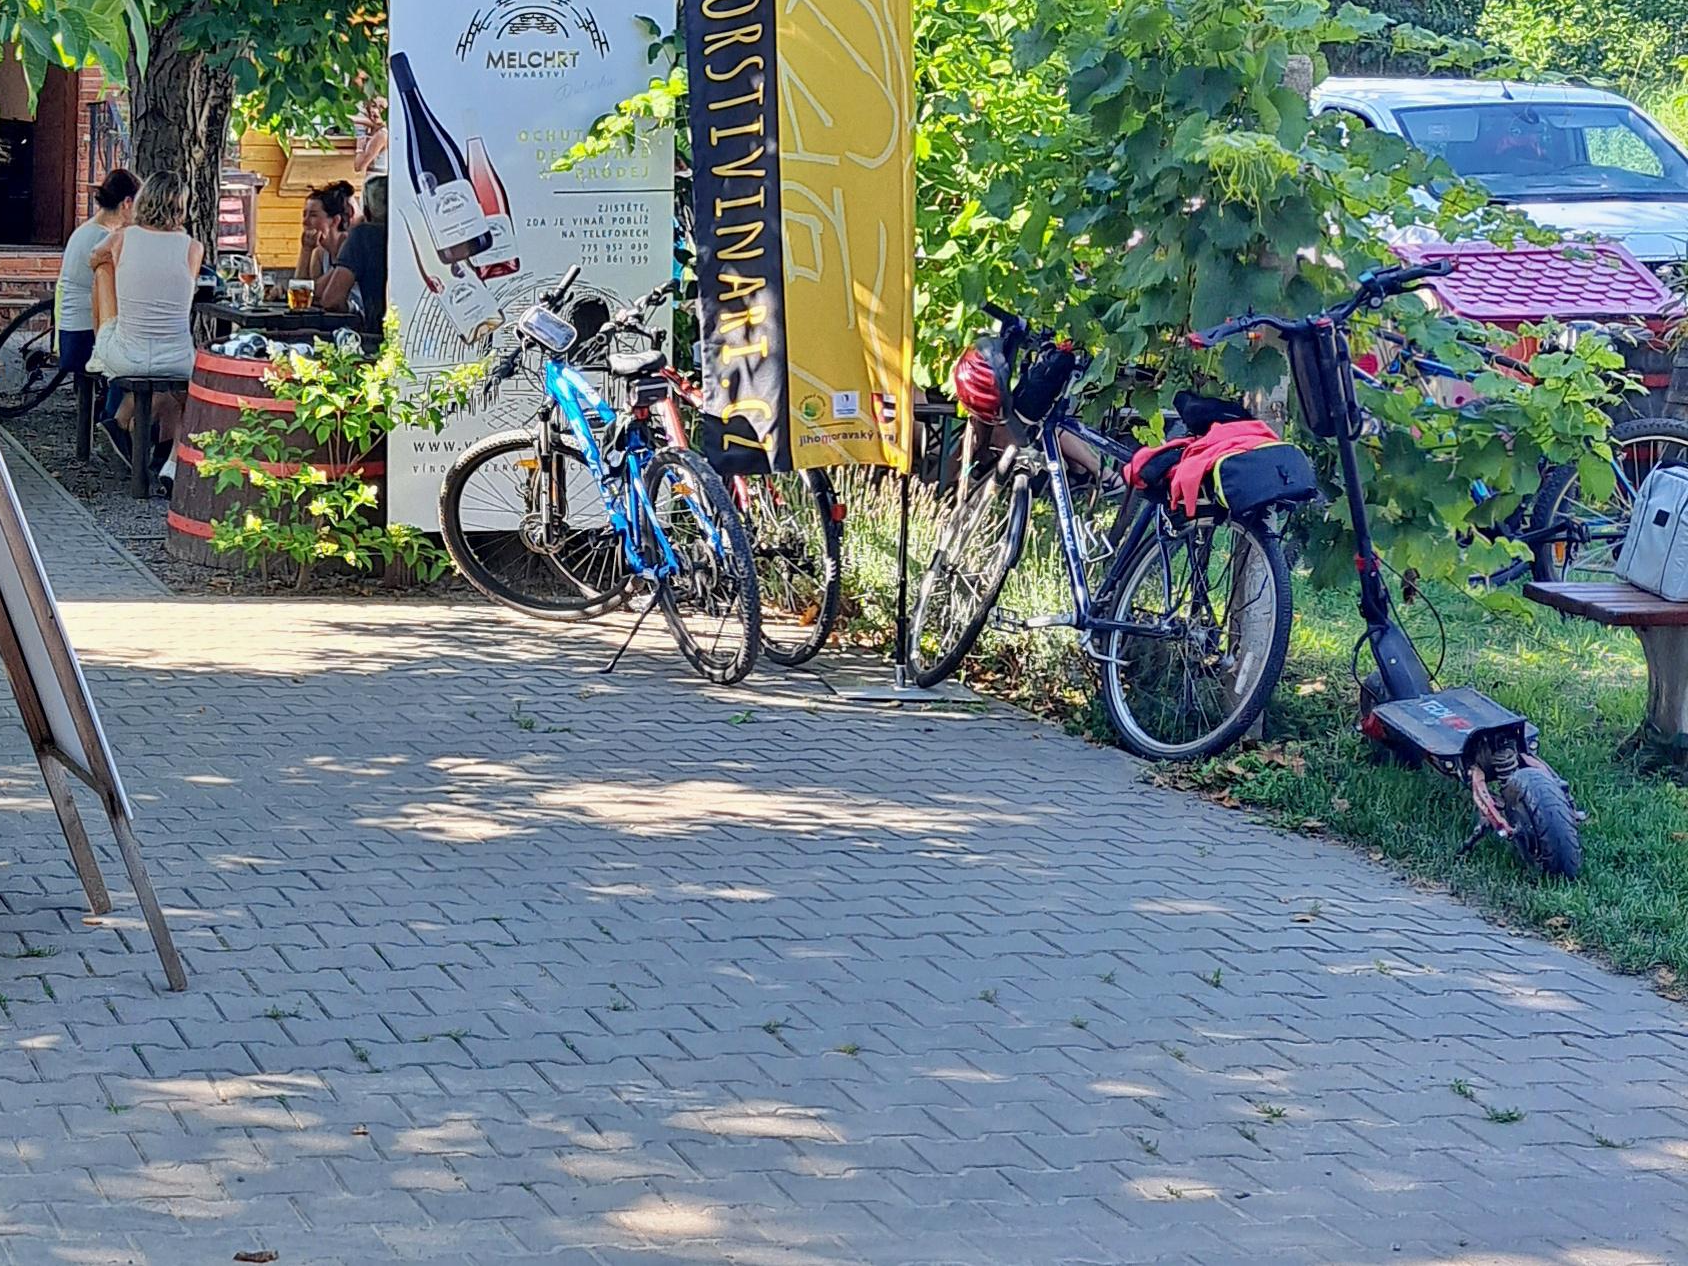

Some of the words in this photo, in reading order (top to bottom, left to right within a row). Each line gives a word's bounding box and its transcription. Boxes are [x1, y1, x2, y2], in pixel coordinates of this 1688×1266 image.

[486, 50, 580, 69] MELCHRT
[598, 202, 649, 213] ZJISTĚTE,
[553, 217, 565, 226] JE
[572, 215, 605, 226] VINAŘ
[612, 214, 649, 225] POBLÍŽ
[561, 230, 575, 239] NA
[583, 229, 649, 238] TELEFONECH
[799, 429, 874, 447] jihomoravský
